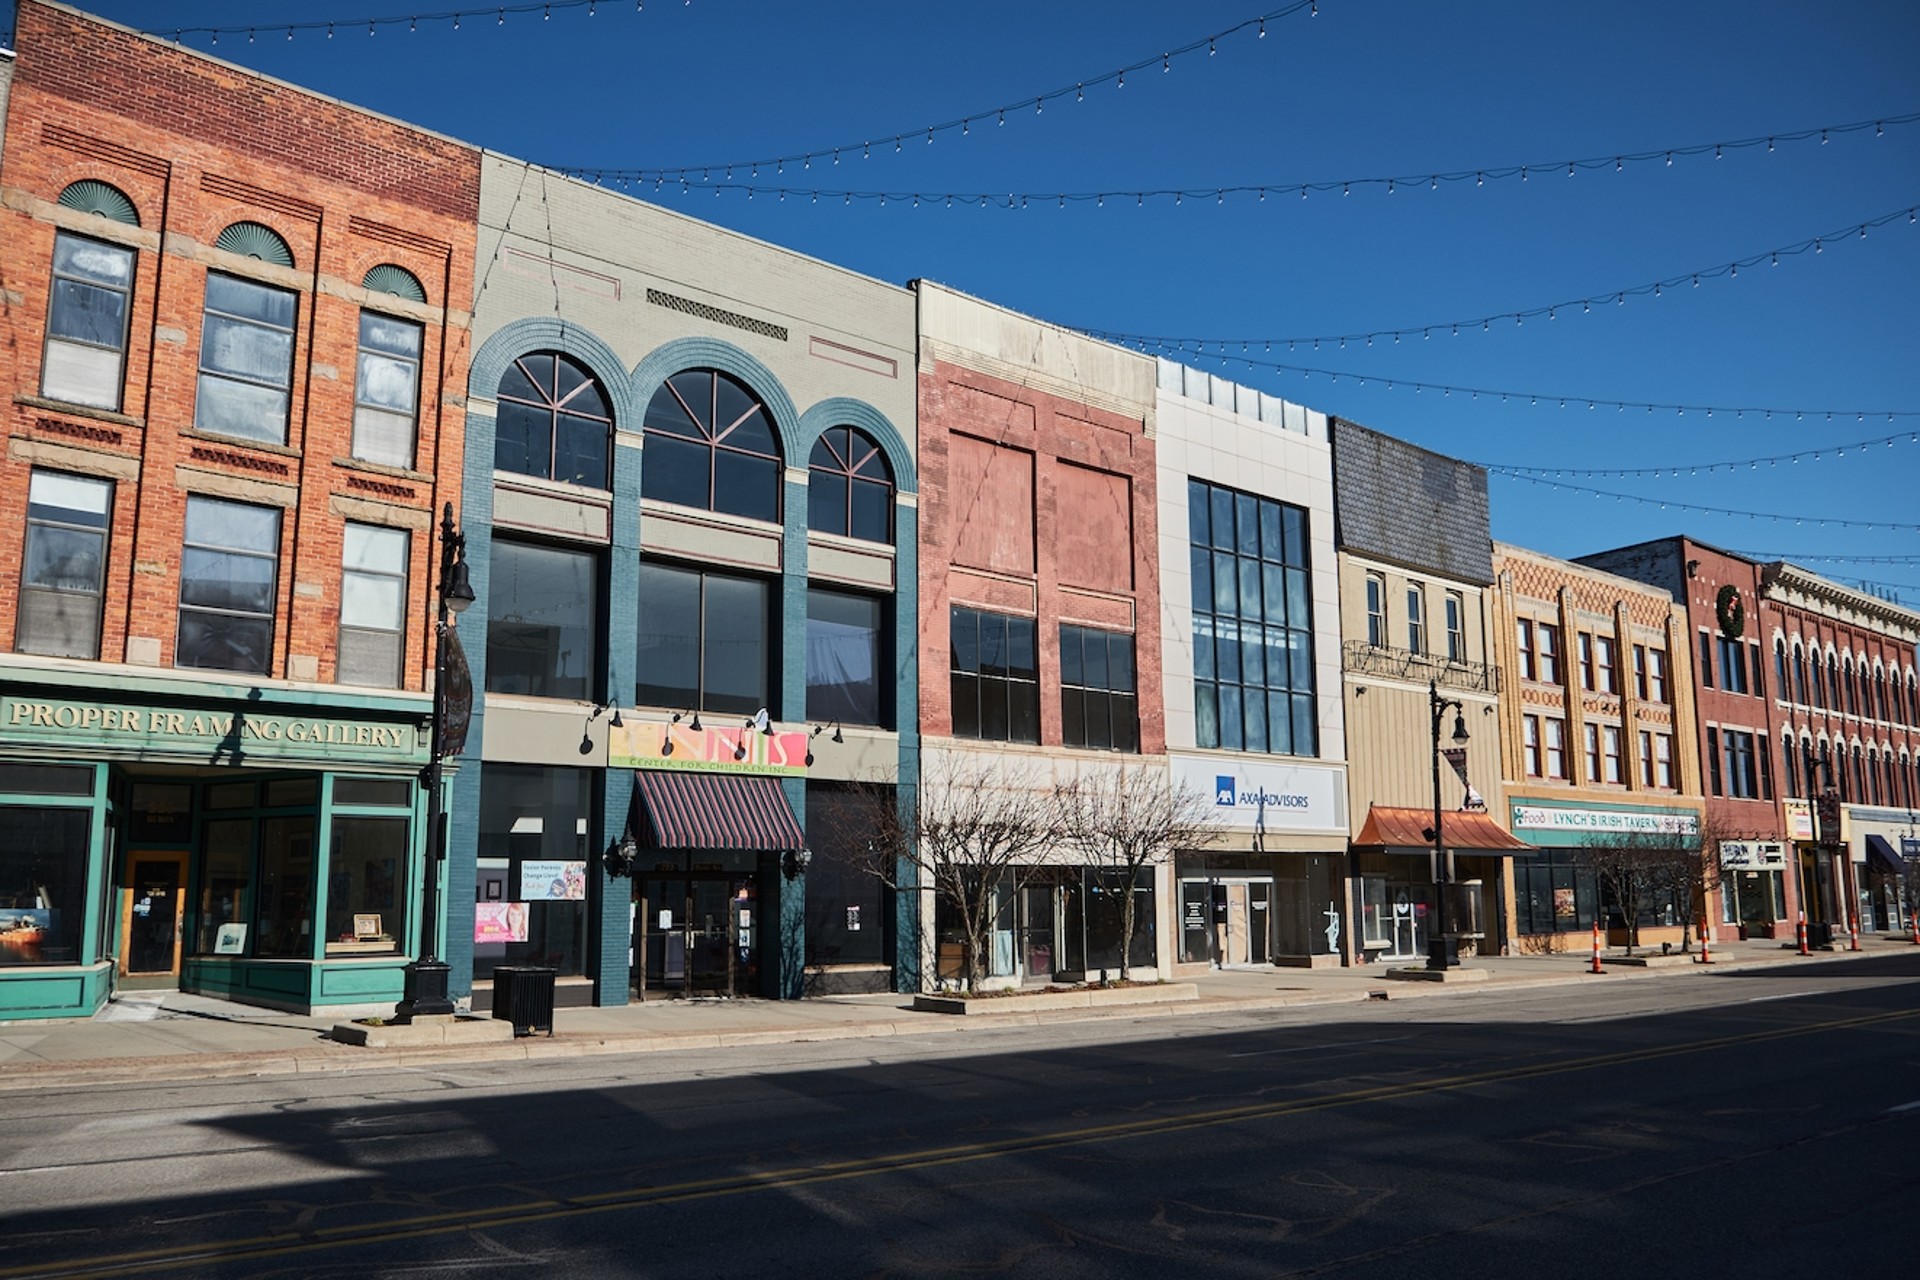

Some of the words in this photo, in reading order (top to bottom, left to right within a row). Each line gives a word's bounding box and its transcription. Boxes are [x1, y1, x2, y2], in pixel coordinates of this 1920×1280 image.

[9, 702, 141, 732] PROPER
[286, 722, 406, 748] GALLERY
[629, 758, 676, 769] CENTER
[680, 761, 705, 770] FOR
[709, 763, 764, 773] CHILDREN
[769, 766, 789, 774] INC
[1262, 793, 1309, 808] ADVISORS
[1524, 810, 1546, 824] Food
[1554, 812, 1597, 826] LYNCH'S
[1599, 814, 1623, 828] IRISH
[1624, 816, 1659, 829] TAVERN
